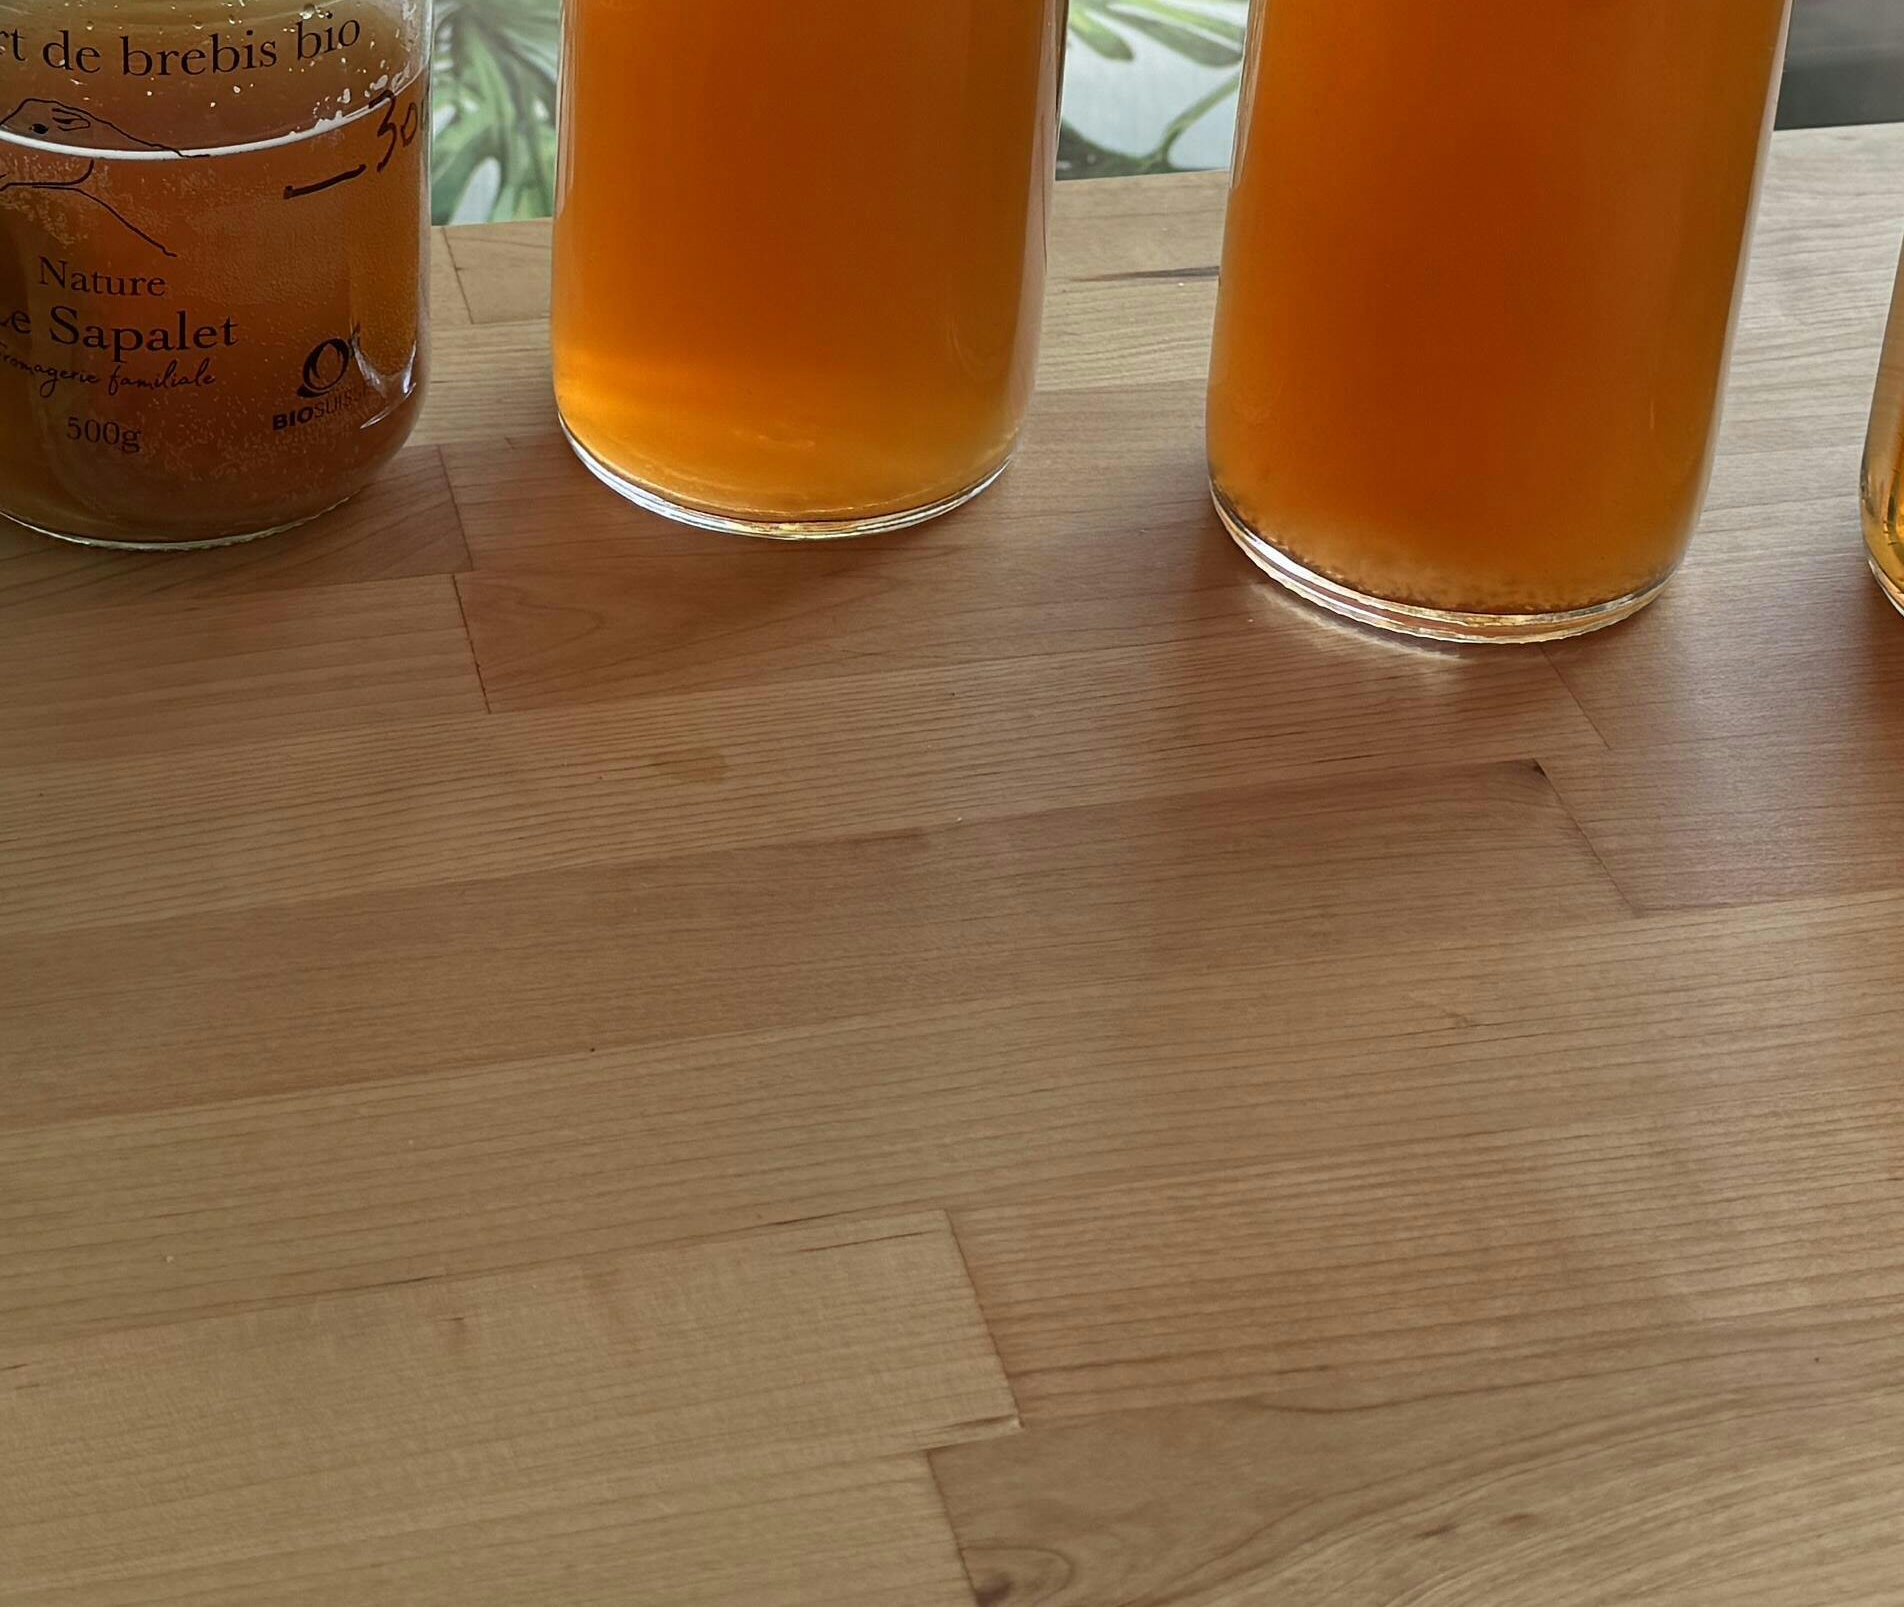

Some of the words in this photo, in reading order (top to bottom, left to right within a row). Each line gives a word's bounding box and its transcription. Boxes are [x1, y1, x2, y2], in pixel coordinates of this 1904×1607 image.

[42, 29, 101, 75] de
[119, 29, 278, 76] brebis
[296, 11, 361, 61] bio
[38, 256, 167, 296] Nature
[49, 305, 239, 363] Sapalet
[107, 357, 217, 396] familiale
[66, 416, 142, 453] 500g
